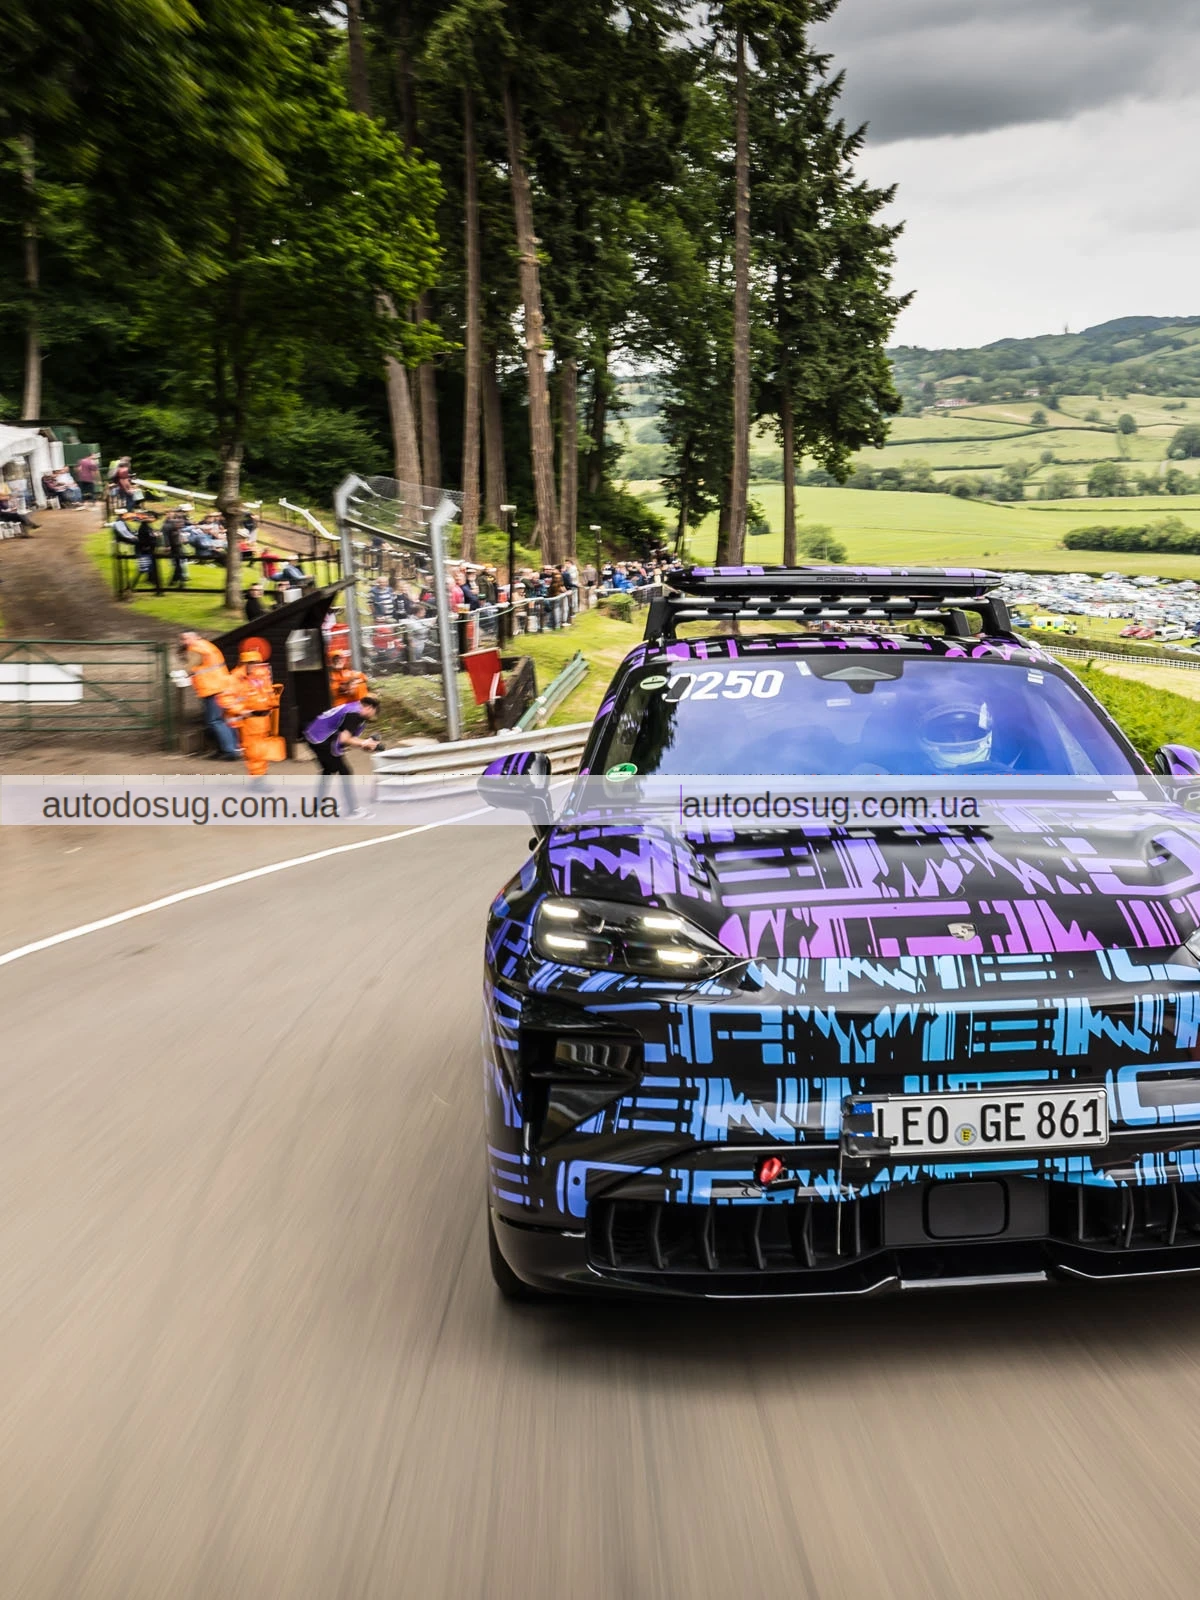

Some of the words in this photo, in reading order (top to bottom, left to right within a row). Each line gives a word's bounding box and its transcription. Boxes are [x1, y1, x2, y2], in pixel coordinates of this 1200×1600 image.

[877, 1105, 950, 1147] LEO
[980, 1102, 1026, 1142] GE
[1037, 1098, 1102, 1139] 861
